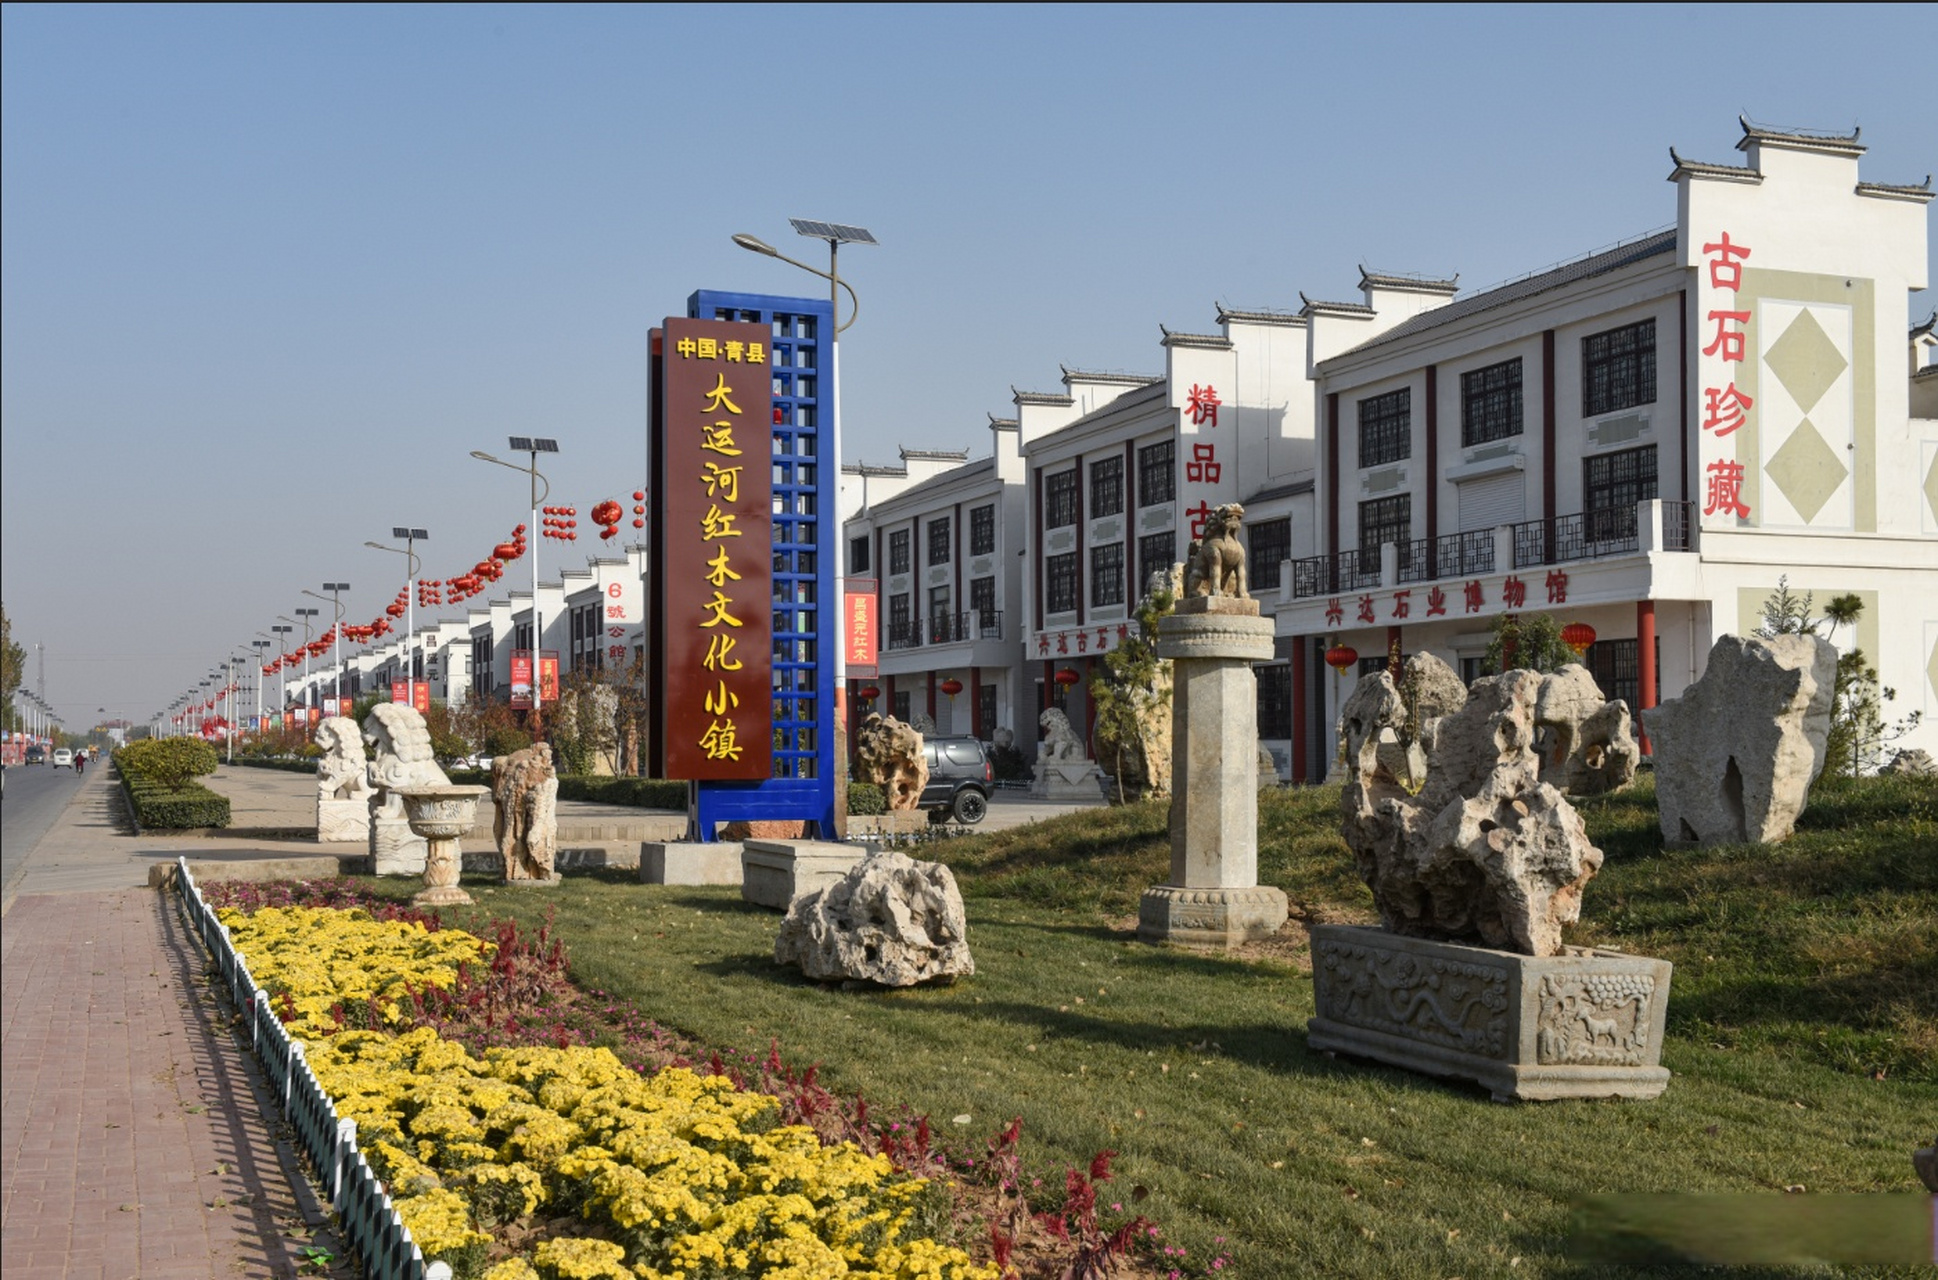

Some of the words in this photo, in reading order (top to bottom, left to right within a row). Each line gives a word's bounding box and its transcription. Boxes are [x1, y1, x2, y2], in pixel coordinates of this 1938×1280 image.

[677, 337, 765, 364] 中国·青县
[1701, 231, 1753, 519] 古石珍藏
[699, 372, 743, 762] 大运河红木文化小镇
[1325, 569, 1568, 627] 兴达石业博物馆
[606, 582, 626, 658] 6號公館
